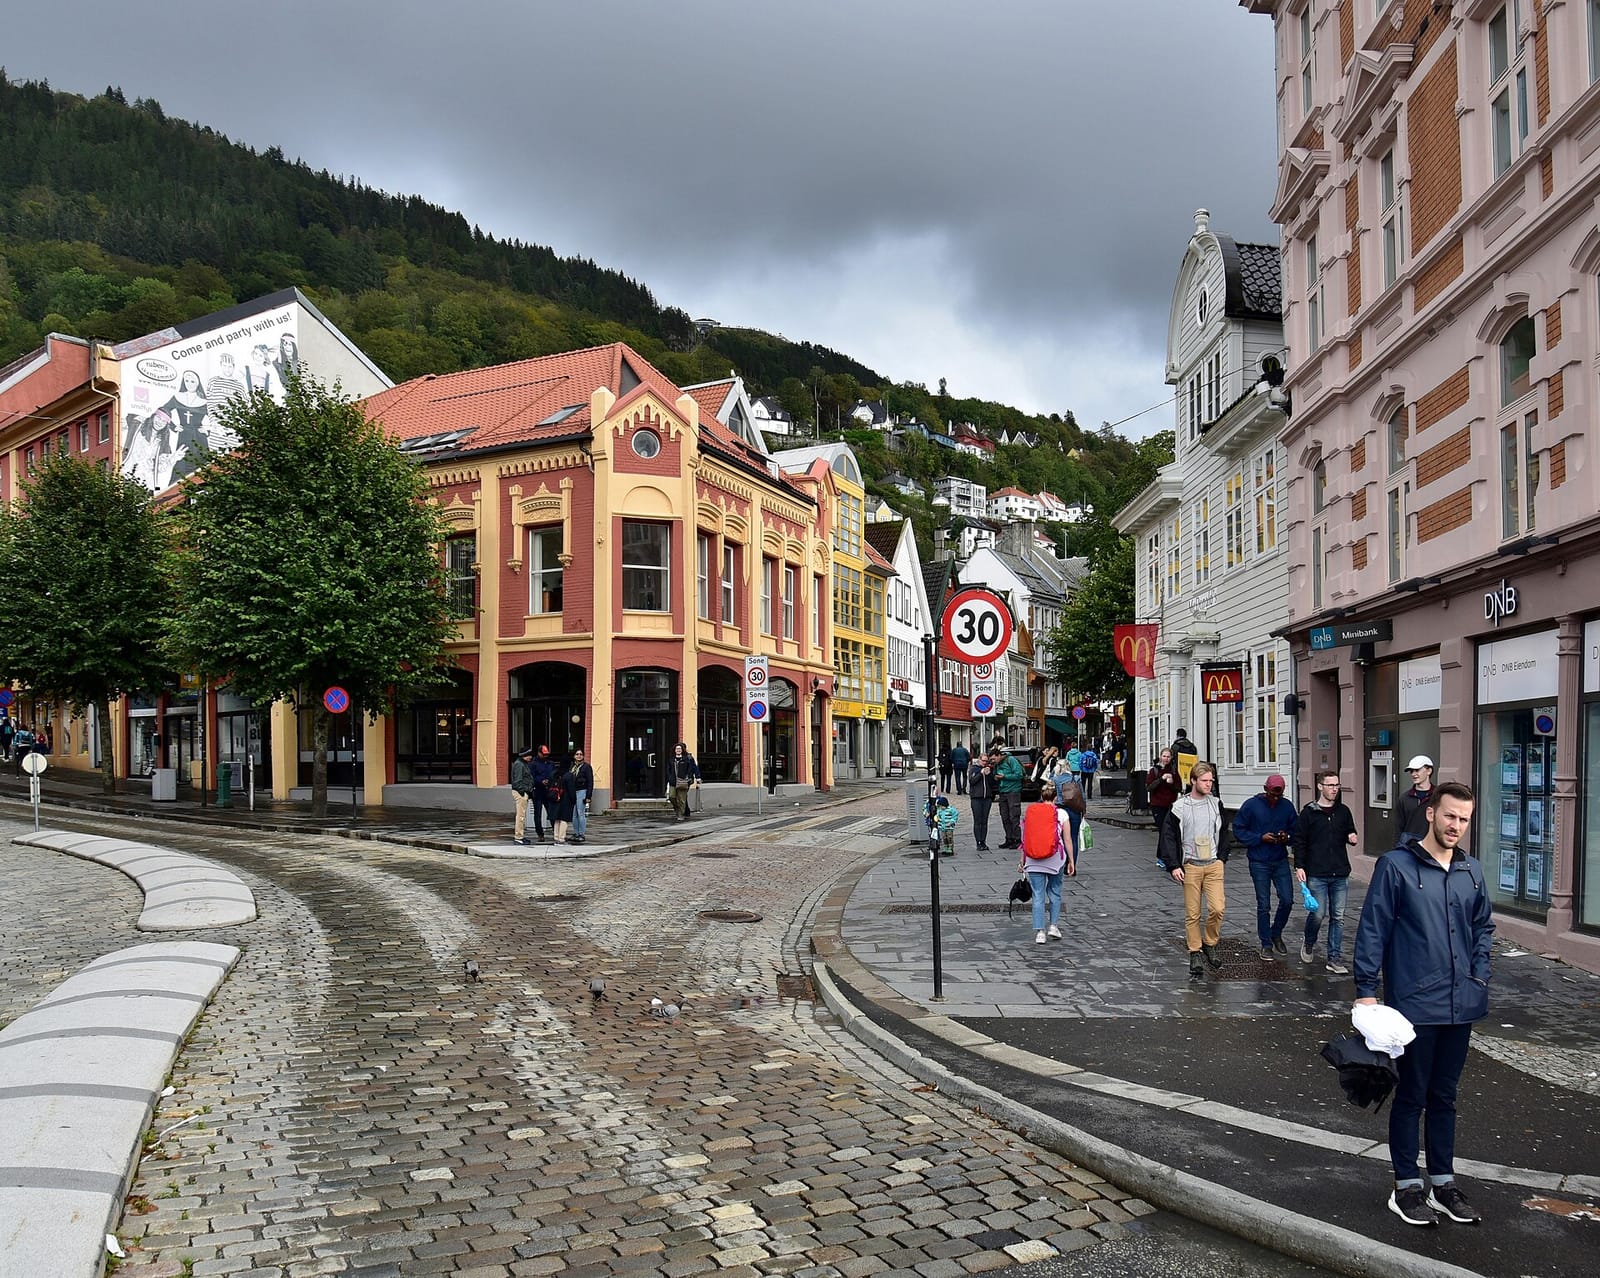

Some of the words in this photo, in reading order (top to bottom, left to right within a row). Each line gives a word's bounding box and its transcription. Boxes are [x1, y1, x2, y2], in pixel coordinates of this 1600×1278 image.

[171, 344, 203, 361] Come
[205, 335, 225, 350] and
[226, 327, 253, 344] party
[254, 318, 275, 332] with
[277, 311, 292, 325] us!
[1484, 578, 1516, 628] DNB
[956, 608, 999, 646] 30
[1313, 627, 1332, 649] DNB
[1341, 627, 1379, 640] Minibank
[751, 671, 763, 682] 30
[976, 664, 989, 676] 30
[1483, 664, 1497, 677] DNB
[1501, 663, 1513, 673] DNB
[1513, 659, 1537, 671] Eiendom
[975, 684, 992, 692] Sone
[1415, 677, 1425, 686] DNB
